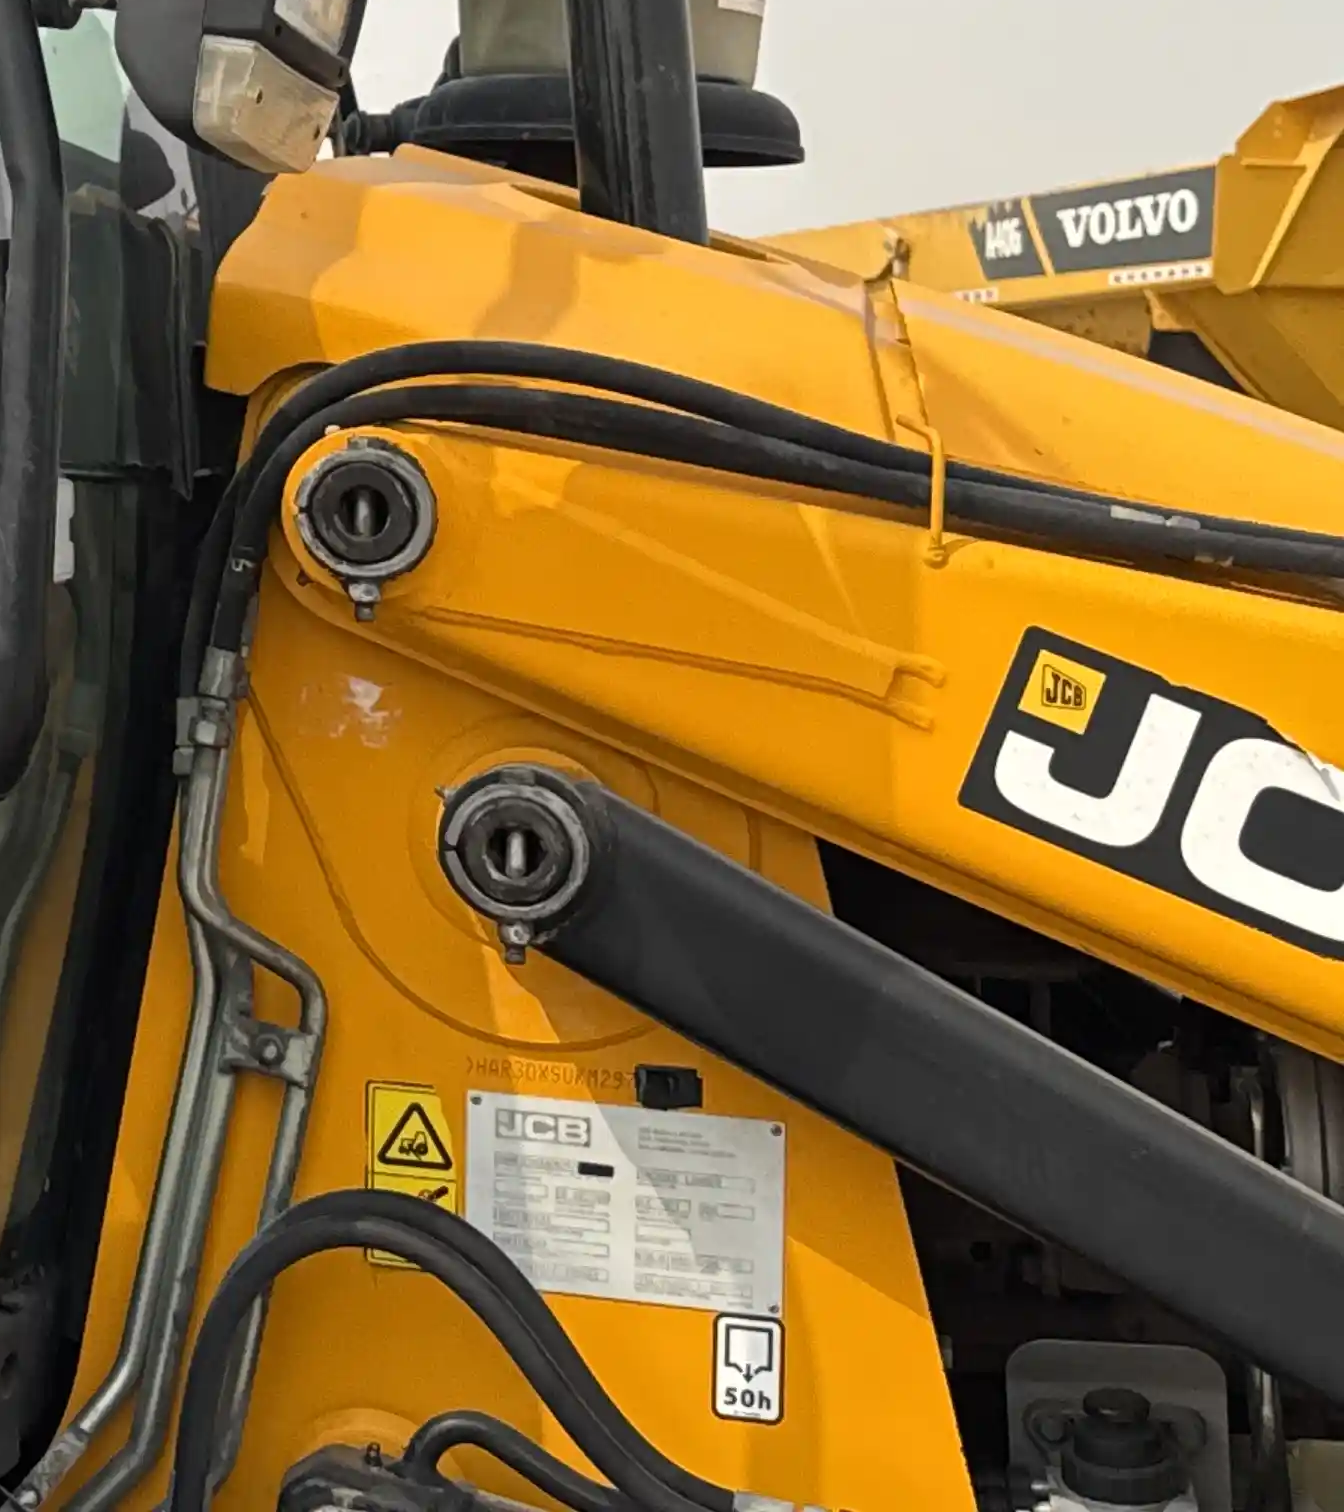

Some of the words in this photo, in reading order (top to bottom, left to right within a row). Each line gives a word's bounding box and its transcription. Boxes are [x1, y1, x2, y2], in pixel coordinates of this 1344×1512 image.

[1055, 188, 1200, 248] VOLVO
[1045, 671, 1085, 707] JCB
[498, 1111, 590, 1146] JCB
[723, 1386, 772, 1411] 50h
